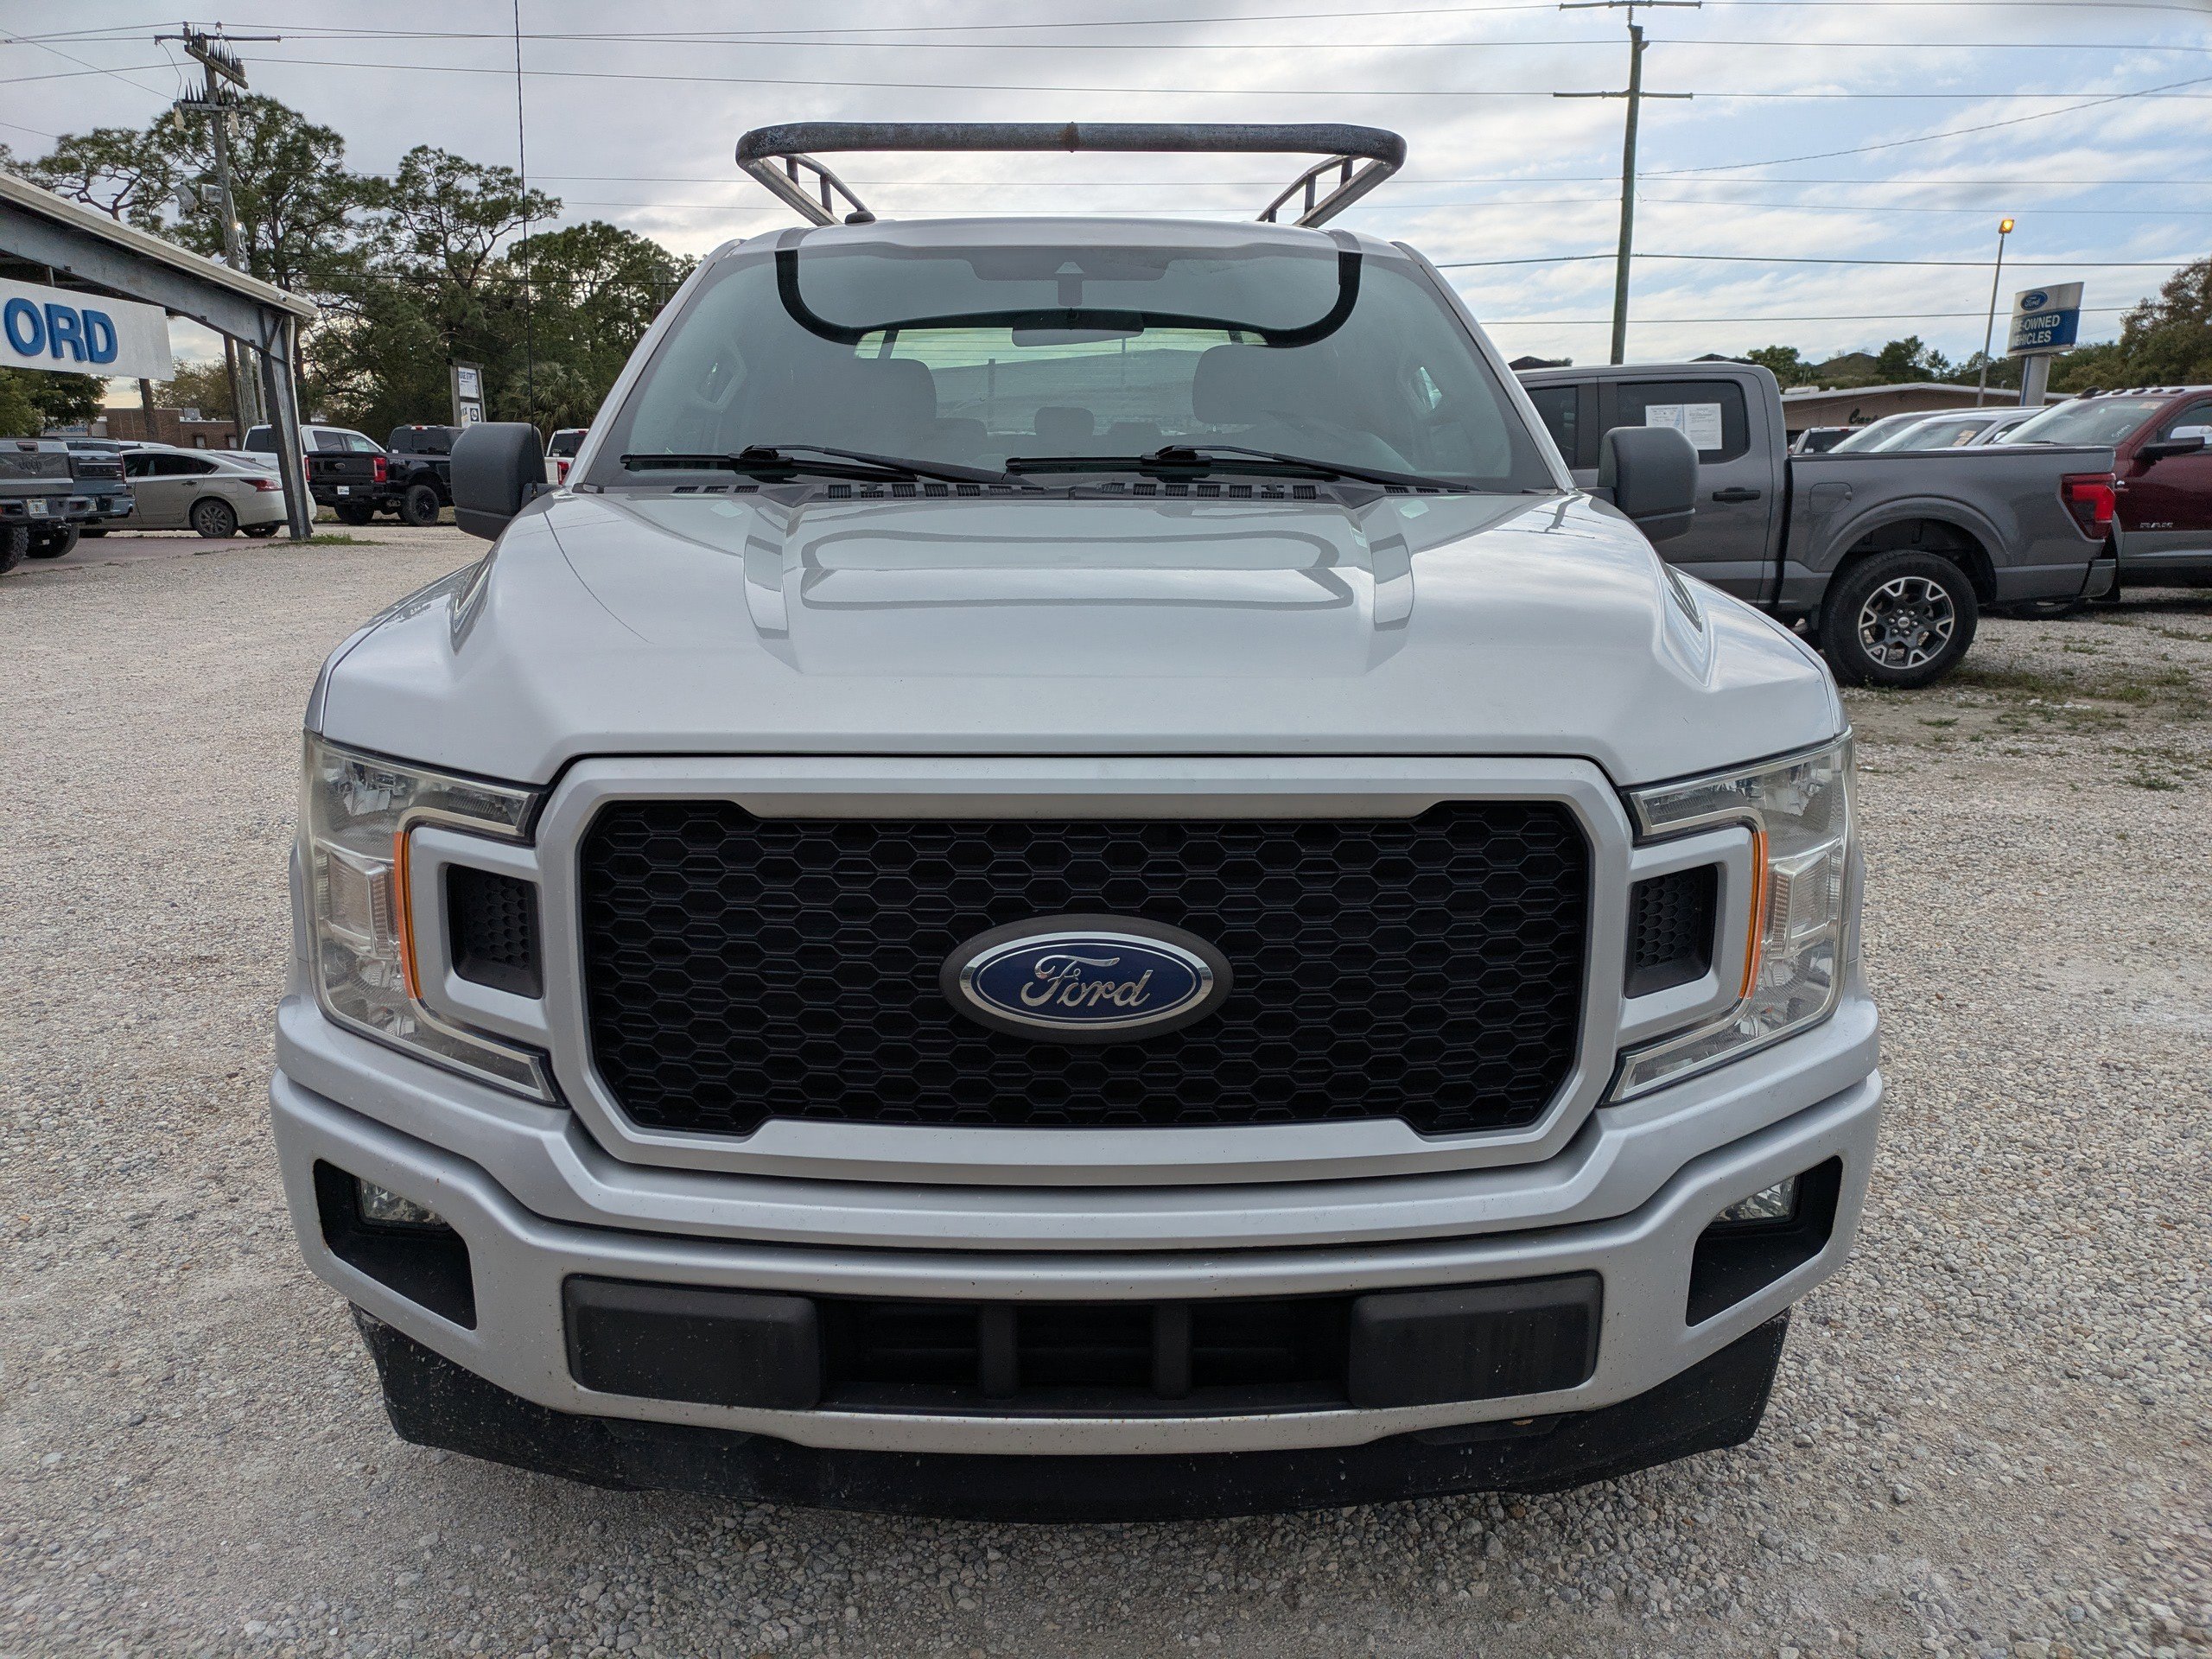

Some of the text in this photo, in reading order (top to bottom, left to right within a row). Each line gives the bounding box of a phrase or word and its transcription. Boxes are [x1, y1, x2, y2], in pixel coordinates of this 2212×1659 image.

[4, 298, 118, 364] ORD
[2012, 315, 2061, 334] RE-OWNED
[1020, 954, 1154, 1007] Ford
